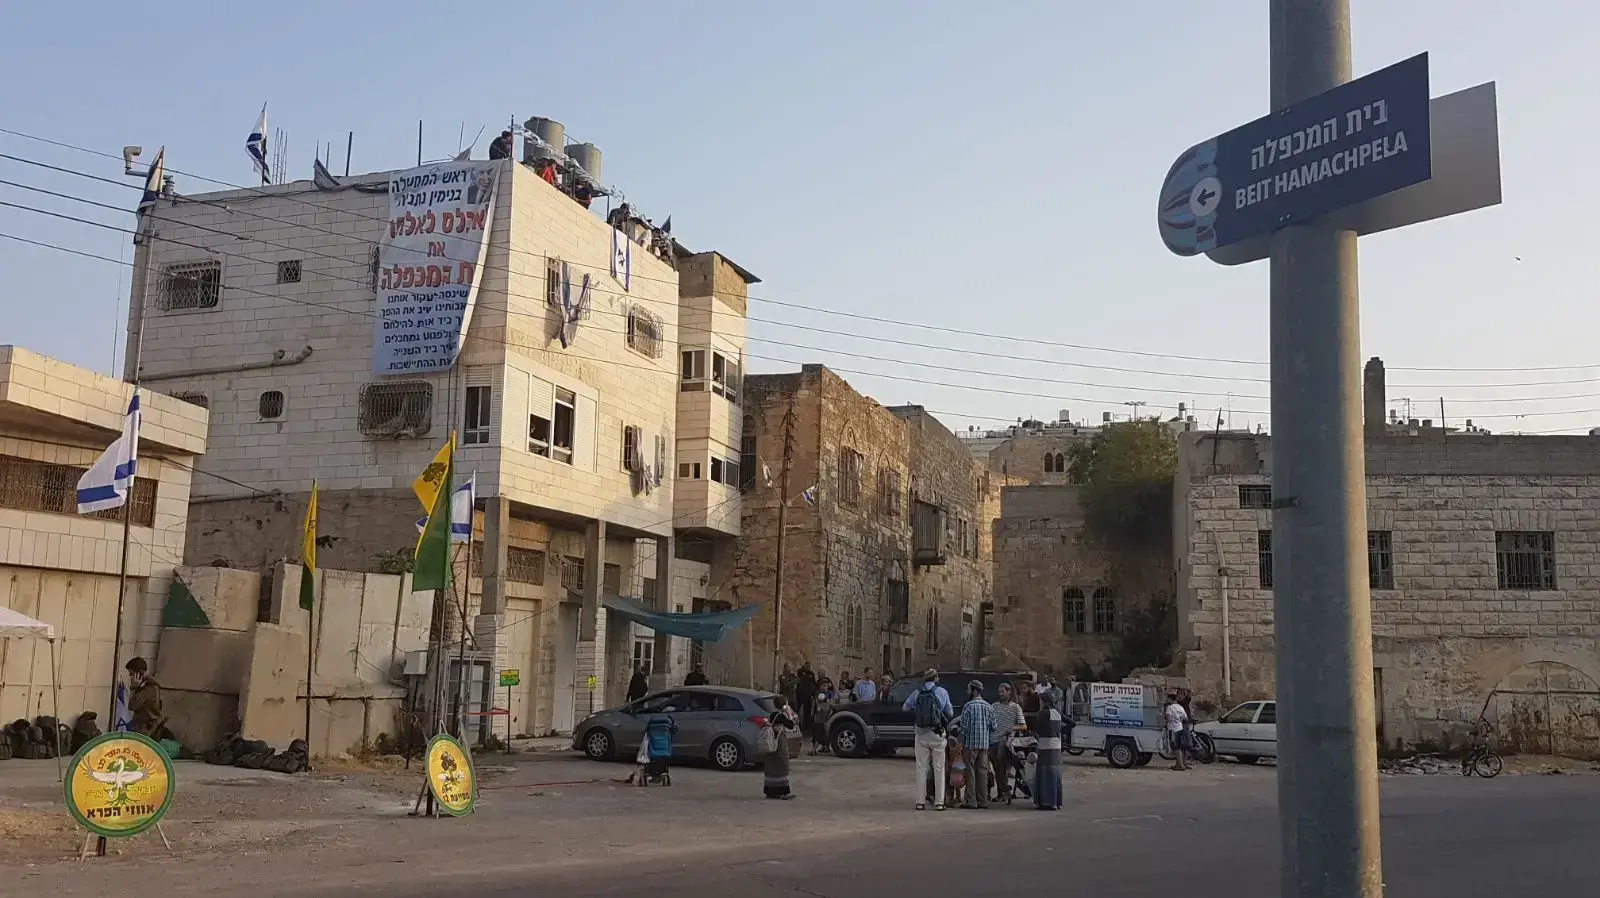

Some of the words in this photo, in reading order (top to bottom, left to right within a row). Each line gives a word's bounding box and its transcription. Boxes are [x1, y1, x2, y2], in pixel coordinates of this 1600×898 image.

[1345, 99, 1388, 136] בית
[1251, 117, 1338, 171] המכפלה
[442, 170, 466, 184] ראש
[1235, 178, 1271, 209] BEIT
[1274, 131, 1408, 195] HAMACHPELA
[429, 189, 462, 207] בנימין
[427, 241, 445, 257] את
[380, 264, 452, 290] המכפלה
[402, 306, 415, 314] את
[437, 317, 452, 325] ביד
[424, 345, 437, 353] ביד
[1093, 685, 1116, 693] עברית
[1117, 686, 1141, 695] עבודה
[86, 806, 121, 818] הפרא
